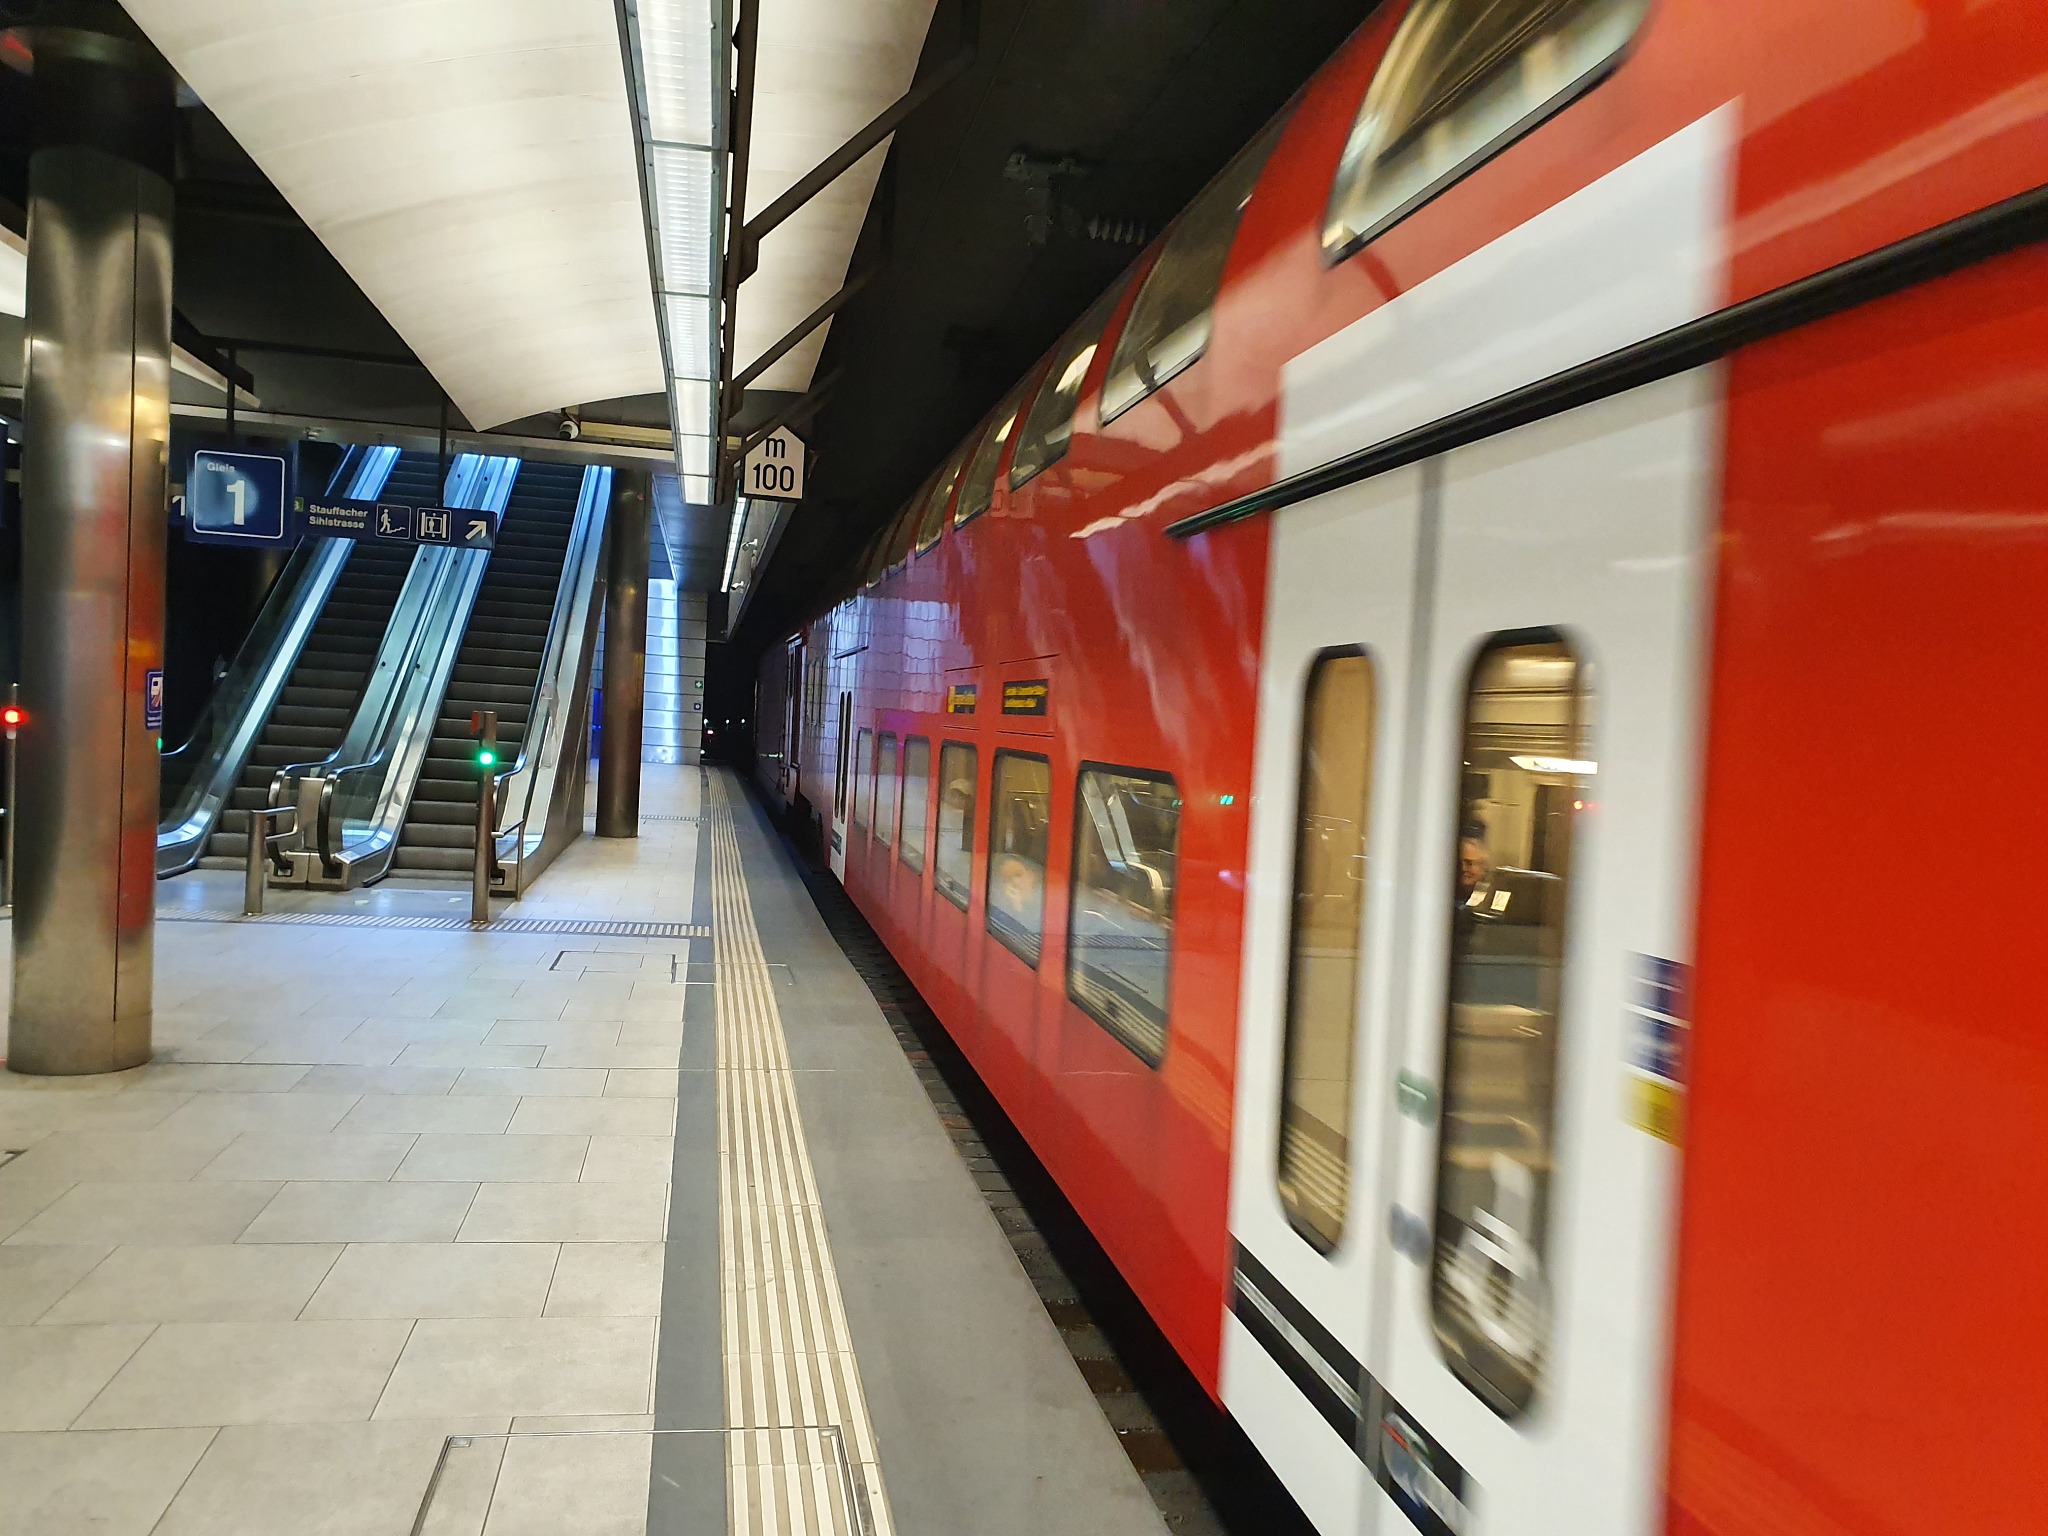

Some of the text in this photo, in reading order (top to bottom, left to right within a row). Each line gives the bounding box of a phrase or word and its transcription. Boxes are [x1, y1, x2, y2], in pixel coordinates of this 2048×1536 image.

[765, 438, 785, 458] m
[206, 462, 235, 473] Gleis
[753, 463, 795, 492] 100
[226, 479, 245, 526] 1
[309, 504, 368, 517] Stauffacher
[309, 516, 365, 529] Sihlstrasse
